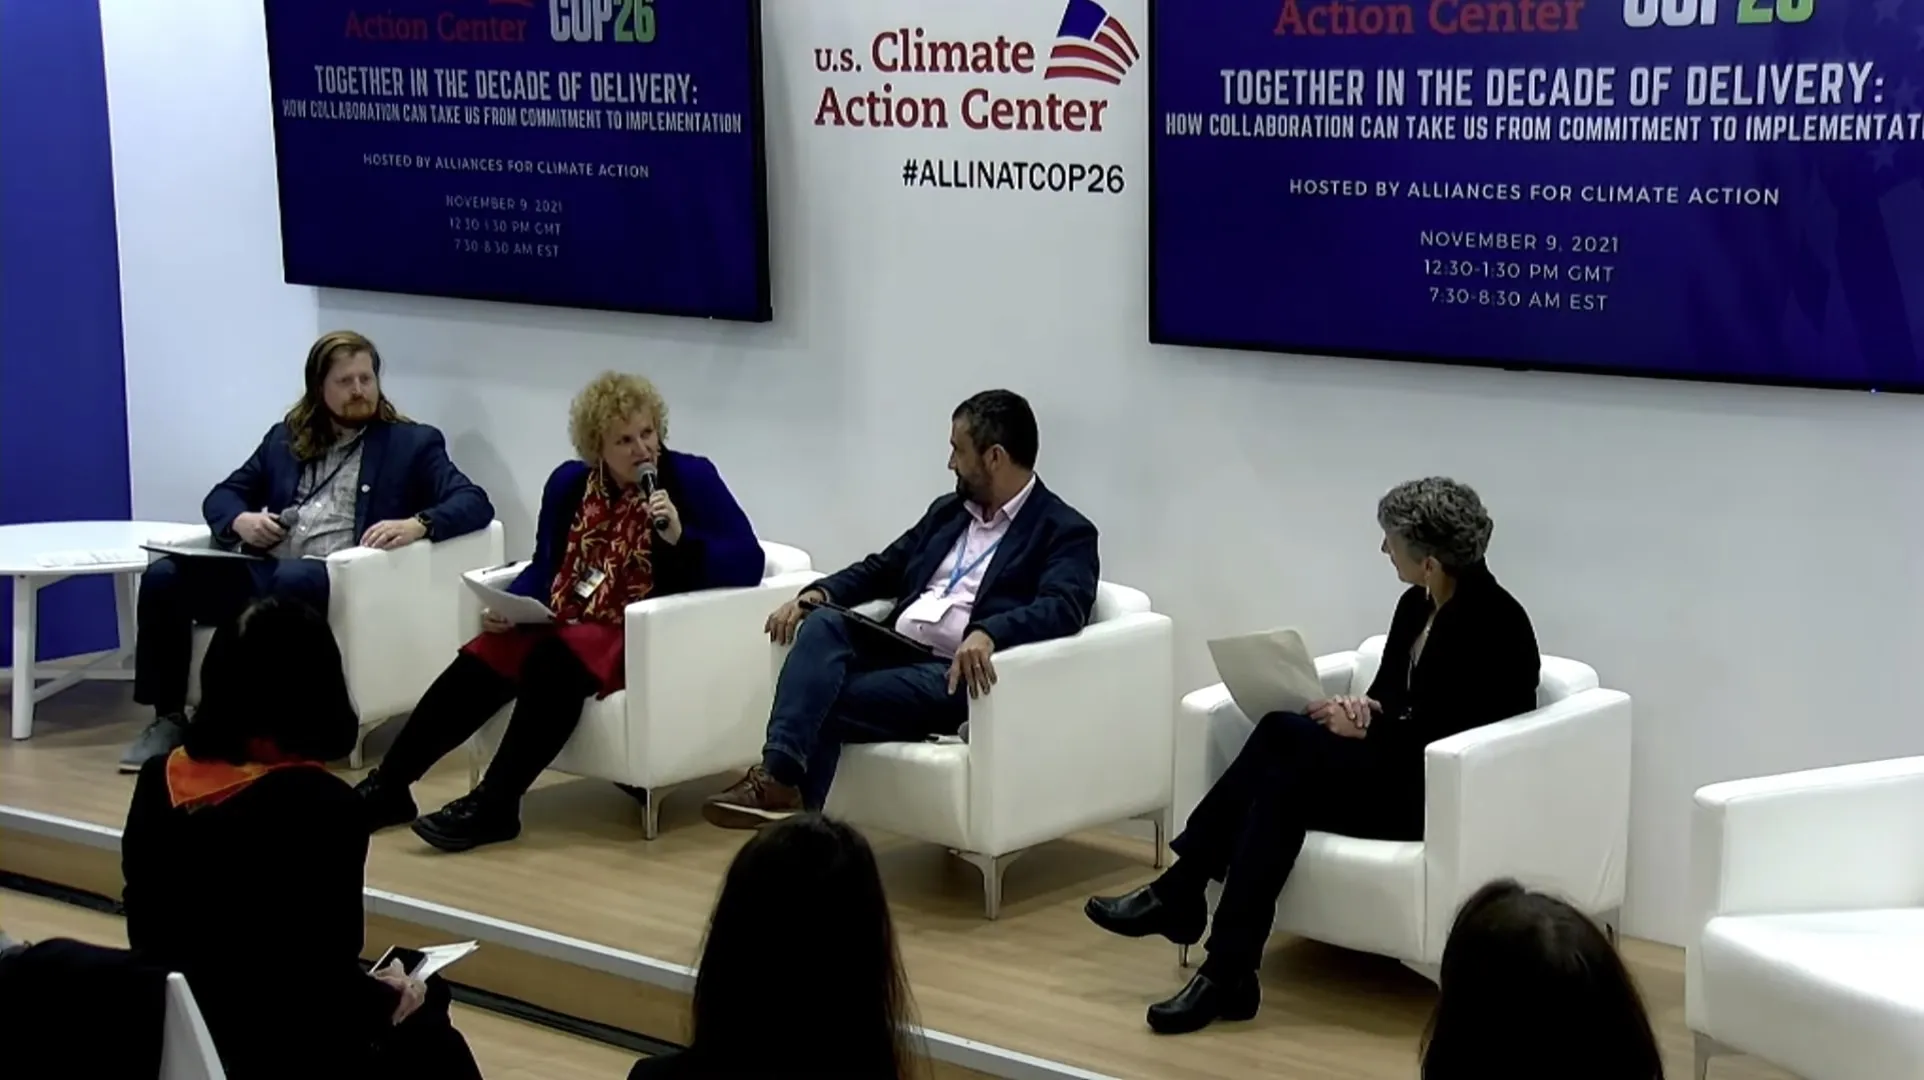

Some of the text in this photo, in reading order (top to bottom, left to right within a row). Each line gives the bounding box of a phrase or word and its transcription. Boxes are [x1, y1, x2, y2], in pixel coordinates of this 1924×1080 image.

[345, 9, 526, 42] Action Center
[549, 0, 656, 42] COP26
[1274, 0, 1415, 35] Action
[1428, 0, 1584, 34] Center
[814, 28, 1035, 73] U.S. Climate
[314, 65, 697, 105] TOGETHER IN THE DECADE OF DELIVERY:
[1220, 61, 1884, 107] TOGETHER IN THE DECADE OF DELIVERY:
[282, 98, 741, 134] HOW COLLABORATION CAN TAKE US FROM COMMITMENT TO IMPLEMENTATION
[814, 84, 1108, 131] Action Center
[1165, 112, 1202, 136] HOW
[1209, 113, 1354, 139] COLLABORATION
[1361, 115, 1399, 140] CAN
[1406, 115, 1456, 140] TAKE
[1463, 116, 1488, 140] US
[1496, 116, 1551, 141] FROM
[1559, 116, 1702, 141] COMMITMENT
[1710, 115, 1737, 141] TO
[363, 153, 649, 178] HOSTED BY ALLIANCES FOR CLIMATE ACTION
[902, 158, 1125, 194] #ALLINATCOP26
[446, 194, 516, 210] NOVEMBER
[520, 198, 530, 212] 9
[1290, 178, 1780, 206] HOSTED BY ALLIANCES FOR CLIMATE ACTION
[511, 219, 530, 233] PM
[1420, 230, 1619, 253] NOVEMBER 9, 2021
[513, 242, 533, 256] AM
[537, 243, 559, 257] EST
[1424, 259, 1614, 282] 12:30-1:30 PM GMT
[1429, 286, 1608, 311] 7:30-8:30 AM EST
